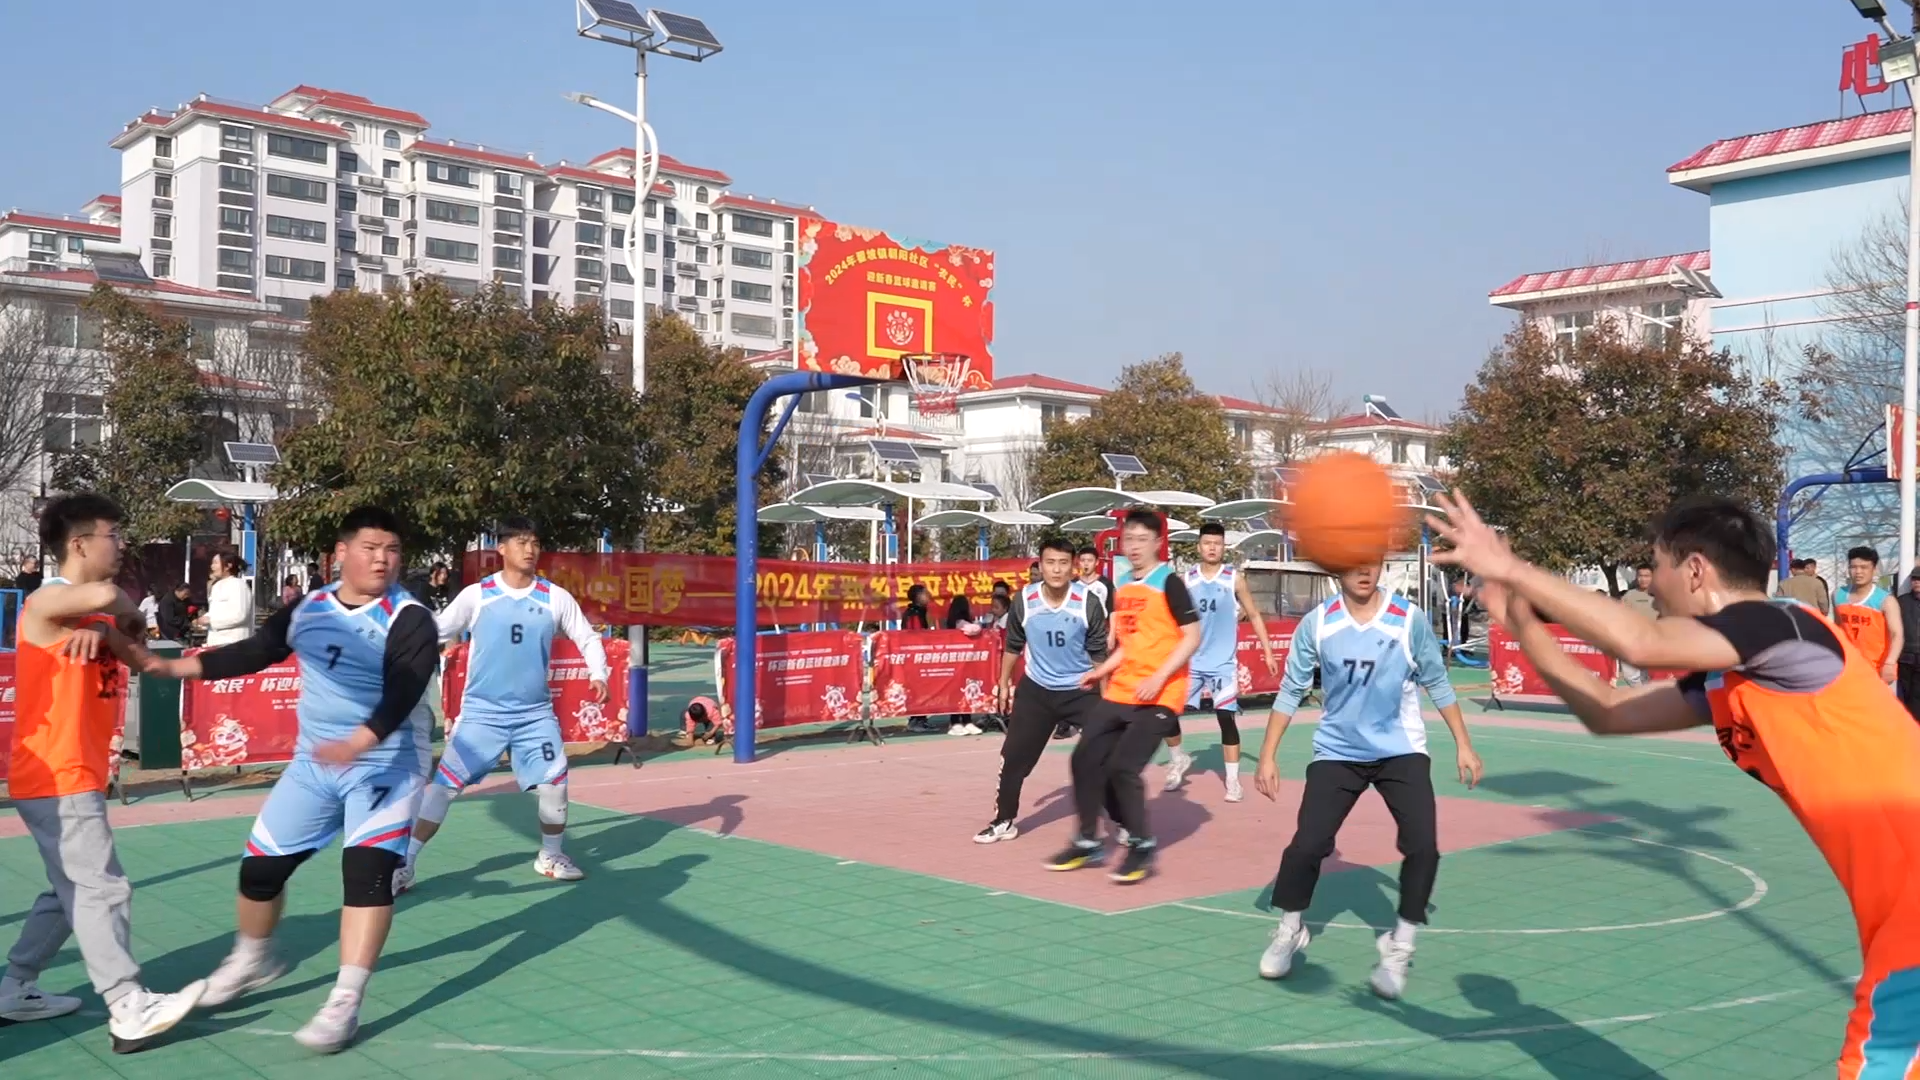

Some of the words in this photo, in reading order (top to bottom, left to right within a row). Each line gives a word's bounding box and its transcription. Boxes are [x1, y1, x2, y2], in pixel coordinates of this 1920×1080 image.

[1199, 598, 1217, 613] 34
[510, 623, 524, 645] 6
[1045, 630, 1066, 648] 16
[1851, 627, 1860, 641] 7
[326, 643, 344, 671] 7
[1343, 658, 1376, 687] 77
[541, 741, 555, 762] 6
[368, 785, 393, 812] 7
